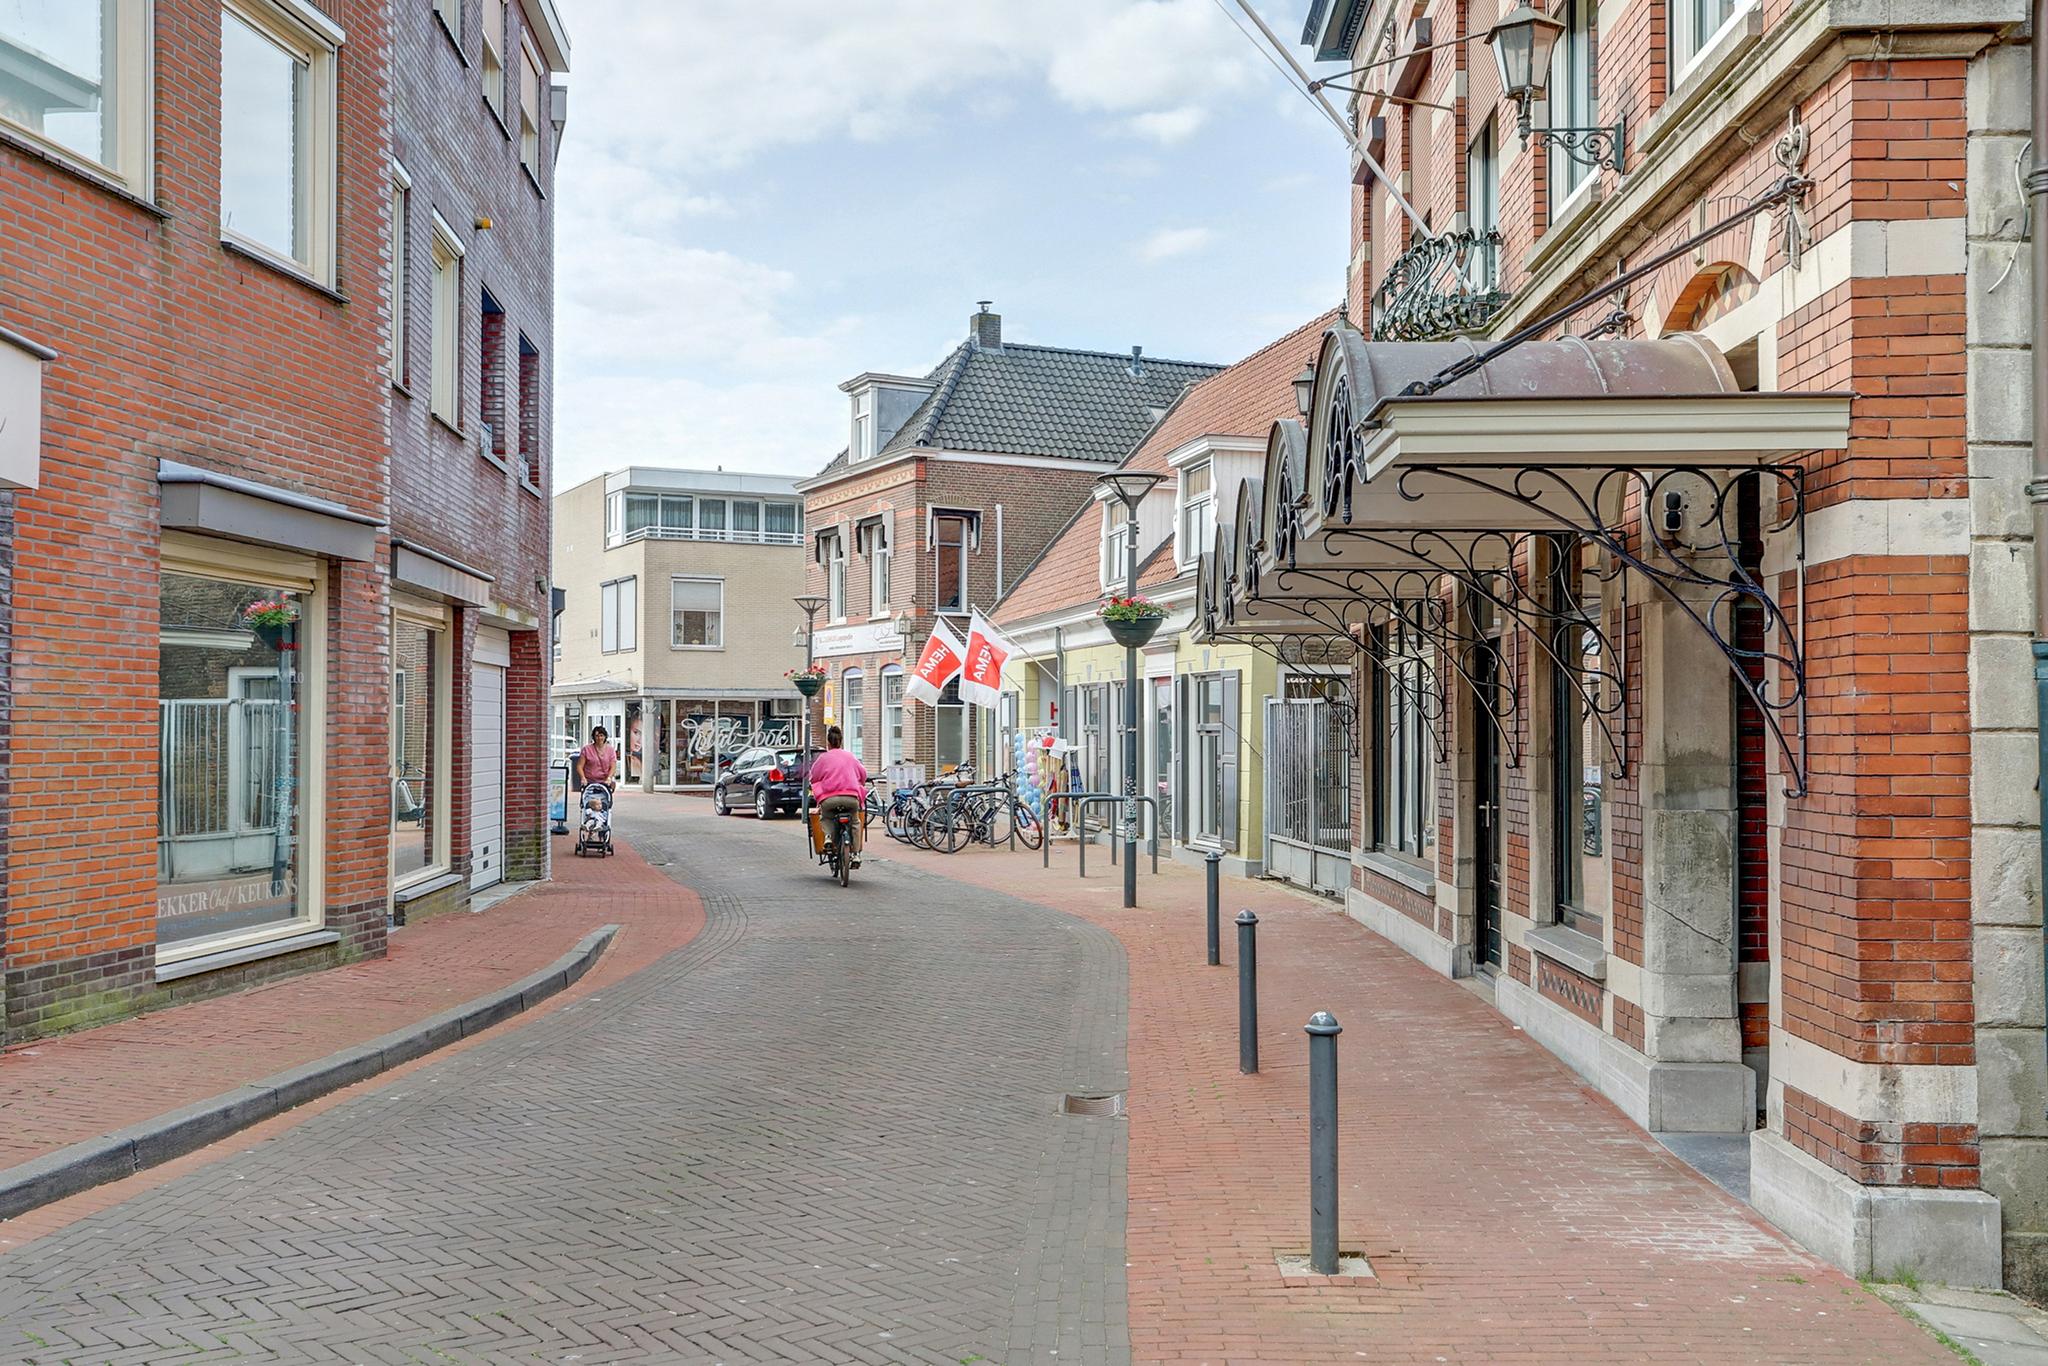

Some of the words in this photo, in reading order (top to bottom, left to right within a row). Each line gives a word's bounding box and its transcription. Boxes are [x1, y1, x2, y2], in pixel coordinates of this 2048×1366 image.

[681, 717, 742, 757] Total
[728, 720, 790, 754] Look
[155, 891, 208, 919] EKKER
[237, 877, 298, 905] KEUKENS
